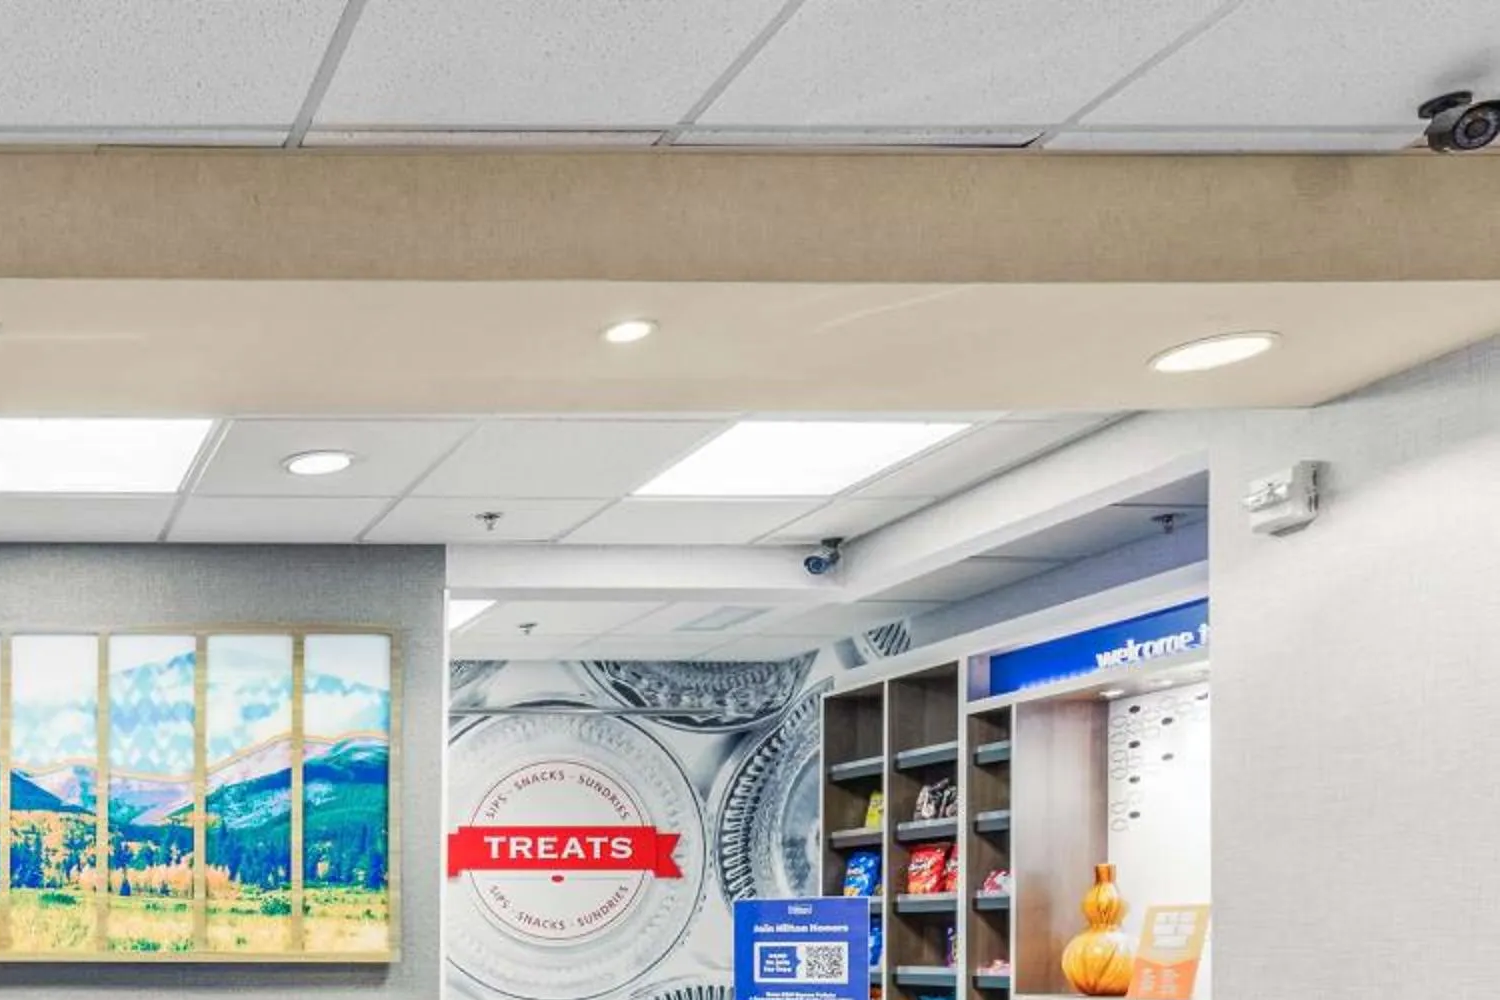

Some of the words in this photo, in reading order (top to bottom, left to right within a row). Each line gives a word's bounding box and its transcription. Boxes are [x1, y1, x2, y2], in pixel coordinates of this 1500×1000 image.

[1095, 631, 1194, 669] welcome
[485, 794, 507, 819] SIPS
[513, 769, 565, 791] SNACKS
[577, 774, 631, 821] SUNDRIES
[484, 836, 633, 859] TREATS
[489, 884, 509, 910] SIPS
[516, 911, 565, 930] SNACKS
[576, 885, 629, 927] SUNDRIES
[776, 923, 809, 932] Hilton
[810, 923, 849, 932] Honors
